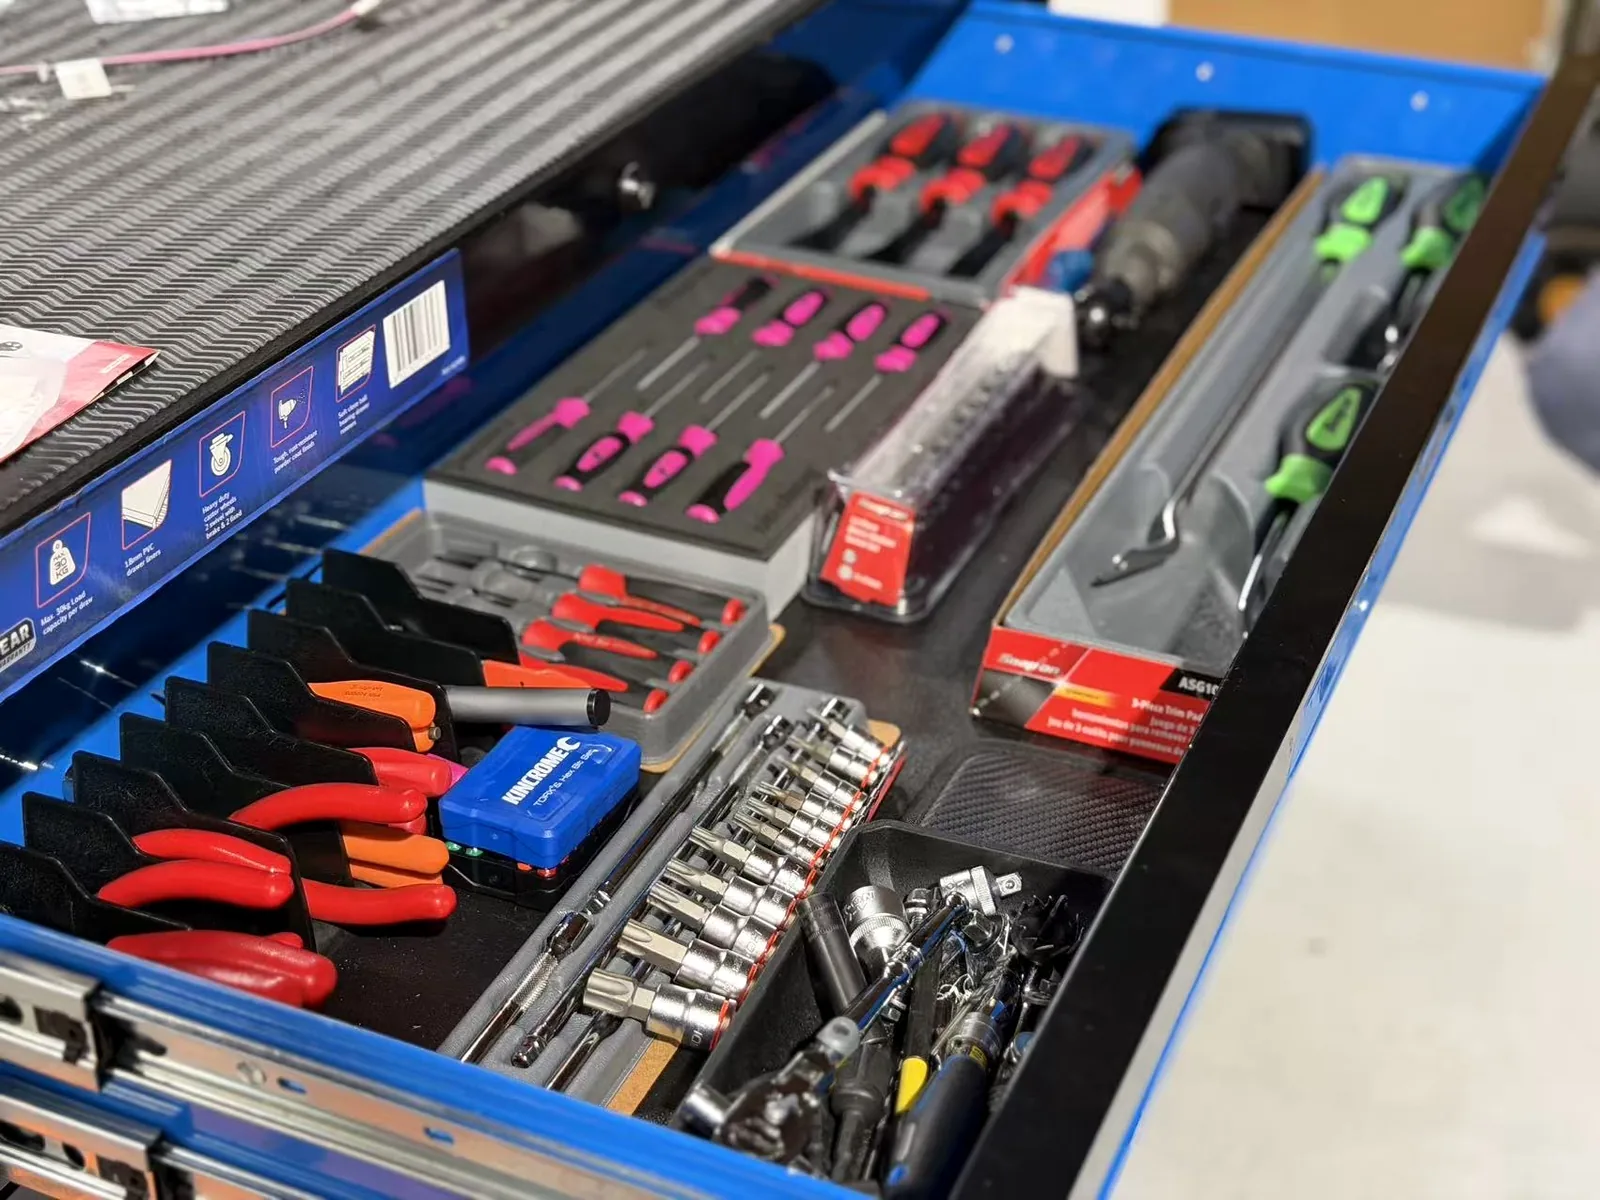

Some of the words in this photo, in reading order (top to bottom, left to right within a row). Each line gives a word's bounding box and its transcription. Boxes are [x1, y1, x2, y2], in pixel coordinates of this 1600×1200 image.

[202, 500, 218, 514] Heavy
[219, 492, 230, 503] duty
[220, 496, 237, 511] wheels
[225, 506, 235, 517] with
[206, 527, 220, 540] brake
[230, 509, 242, 522] fixed
[54, 552, 65, 561] MAX
[143, 543, 155, 556] PVC
[55, 557, 67, 571] 30
[126, 559, 146, 577] drawer
[146, 549, 161, 564] liners
[56, 567, 69, 579] KG
[41, 615, 55, 626] Max.
[56, 603, 71, 616] 30kg
[71, 590, 86, 605] Load
[43, 614, 68, 635] capacity
[68, 607, 78, 620] per
[79, 596, 94, 609] draw
[1165, 704, 1186, 718] Trim
[501, 746, 571, 806] KINCROME
[559, 769, 576, 783] Hex
[571, 760, 584, 770] Bit
